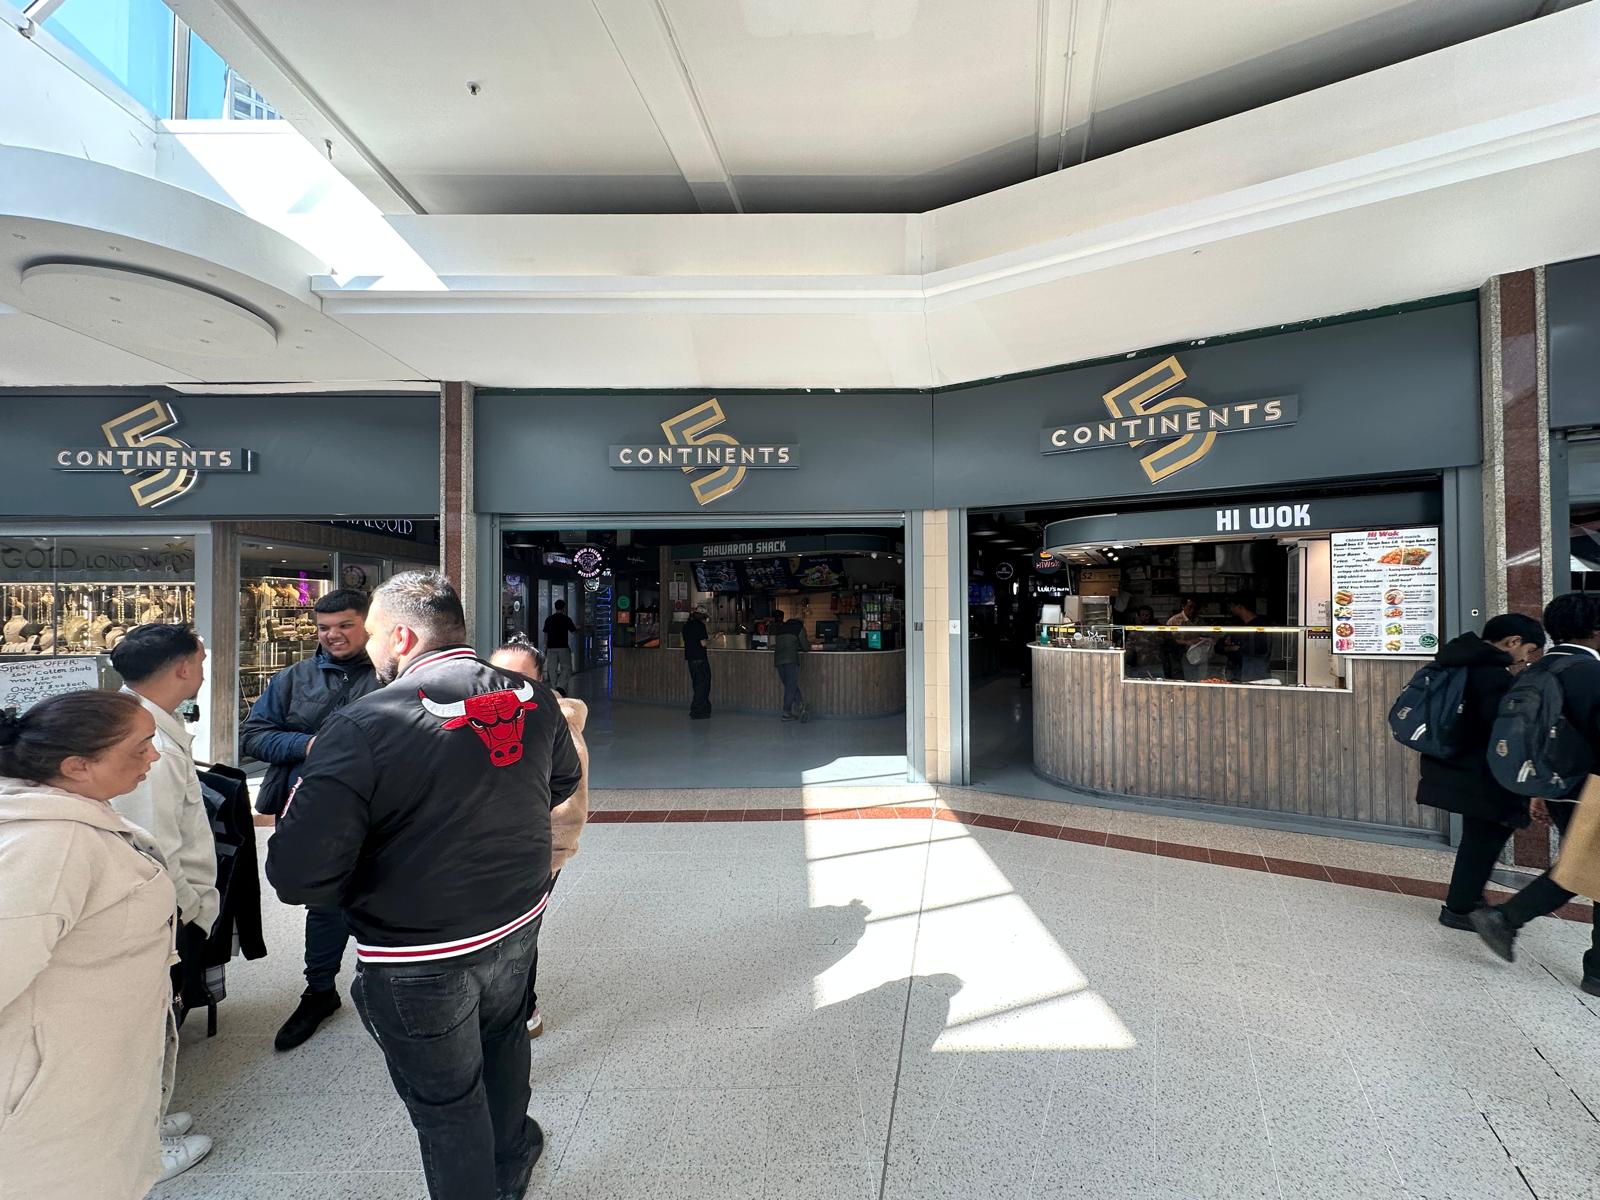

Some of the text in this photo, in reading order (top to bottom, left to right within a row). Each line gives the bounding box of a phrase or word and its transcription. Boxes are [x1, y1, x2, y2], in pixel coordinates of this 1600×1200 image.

[1051, 399, 1282, 447] CONTINENTS
[1103, 355, 1217, 485] 5
[57, 449, 232, 467] CONTINENTS
[101, 400, 196, 508] 5
[619, 446, 790, 466] CONTINENTS
[661, 397, 747, 506] 5
[1216, 504, 1311, 531] HI WOK
[2, 547, 161, 569] GOLD LONDON
[702, 540, 786, 557] SHAWARMA SHACK
